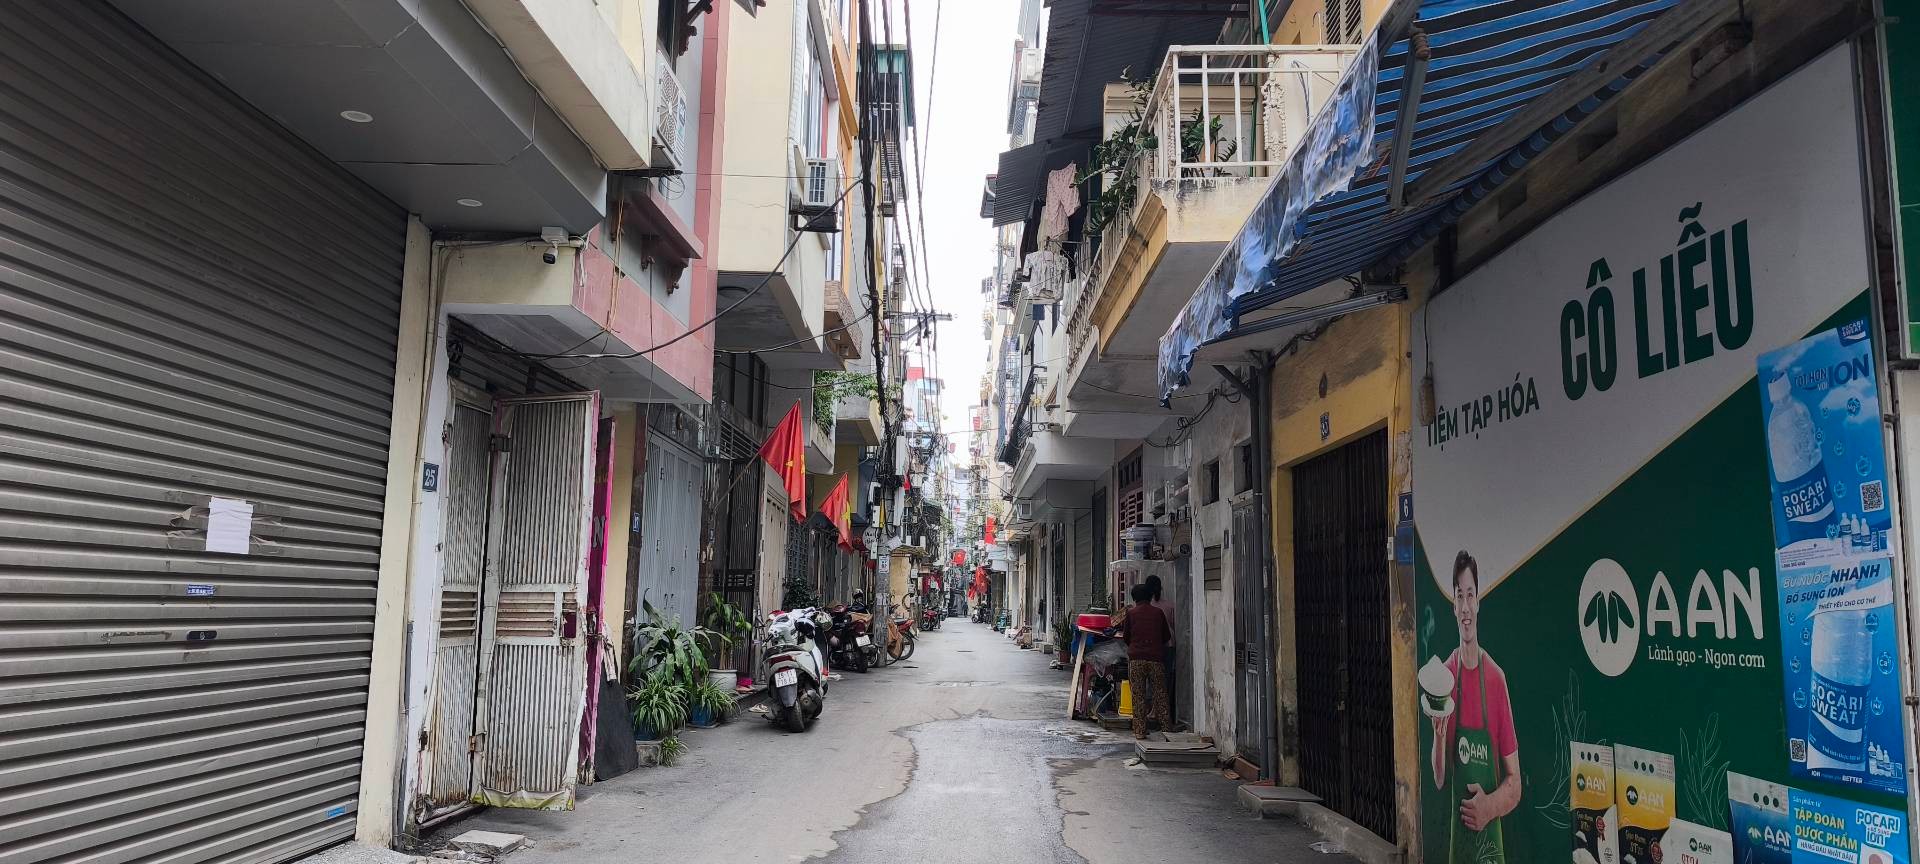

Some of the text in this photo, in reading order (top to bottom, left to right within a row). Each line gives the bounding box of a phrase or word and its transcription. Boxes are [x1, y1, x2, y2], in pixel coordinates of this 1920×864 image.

[1560, 202, 1754, 400] CÔ LIỄU
[1829, 353, 1870, 387] ION
[1462, 394, 1493, 440] TẠP
[1498, 371, 1540, 423] HÓA
[424, 468, 436, 487] 25
[1782, 477, 1828, 507] POCARI
[1785, 491, 1826, 518] SWEAT
[1403, 498, 1409, 517] 6
[1830, 564, 1881, 583] NHANH
[1646, 566, 1764, 641] AAN
[1801, 590, 1825, 602] SUNG
[1827, 586, 1846, 598] ION
[1648, 643, 1675, 662] Lành
[1676, 649, 1696, 667] gạo
[1704, 648, 1737, 669] Ngon
[1738, 652, 1766, 668] cơm
[1811, 680, 1863, 710] POCARI
[1811, 694, 1858, 725] SWEAT
[1470, 742, 1488, 760] AAN
[1586, 776, 1606, 792] AAN
[1640, 788, 1665, 808] AAN
[1794, 807, 1845, 830] TẬP ĐOÀN
[1857, 809, 1899, 833] POCARI
[1795, 825, 1858, 851] DƯỢC PHẨM
